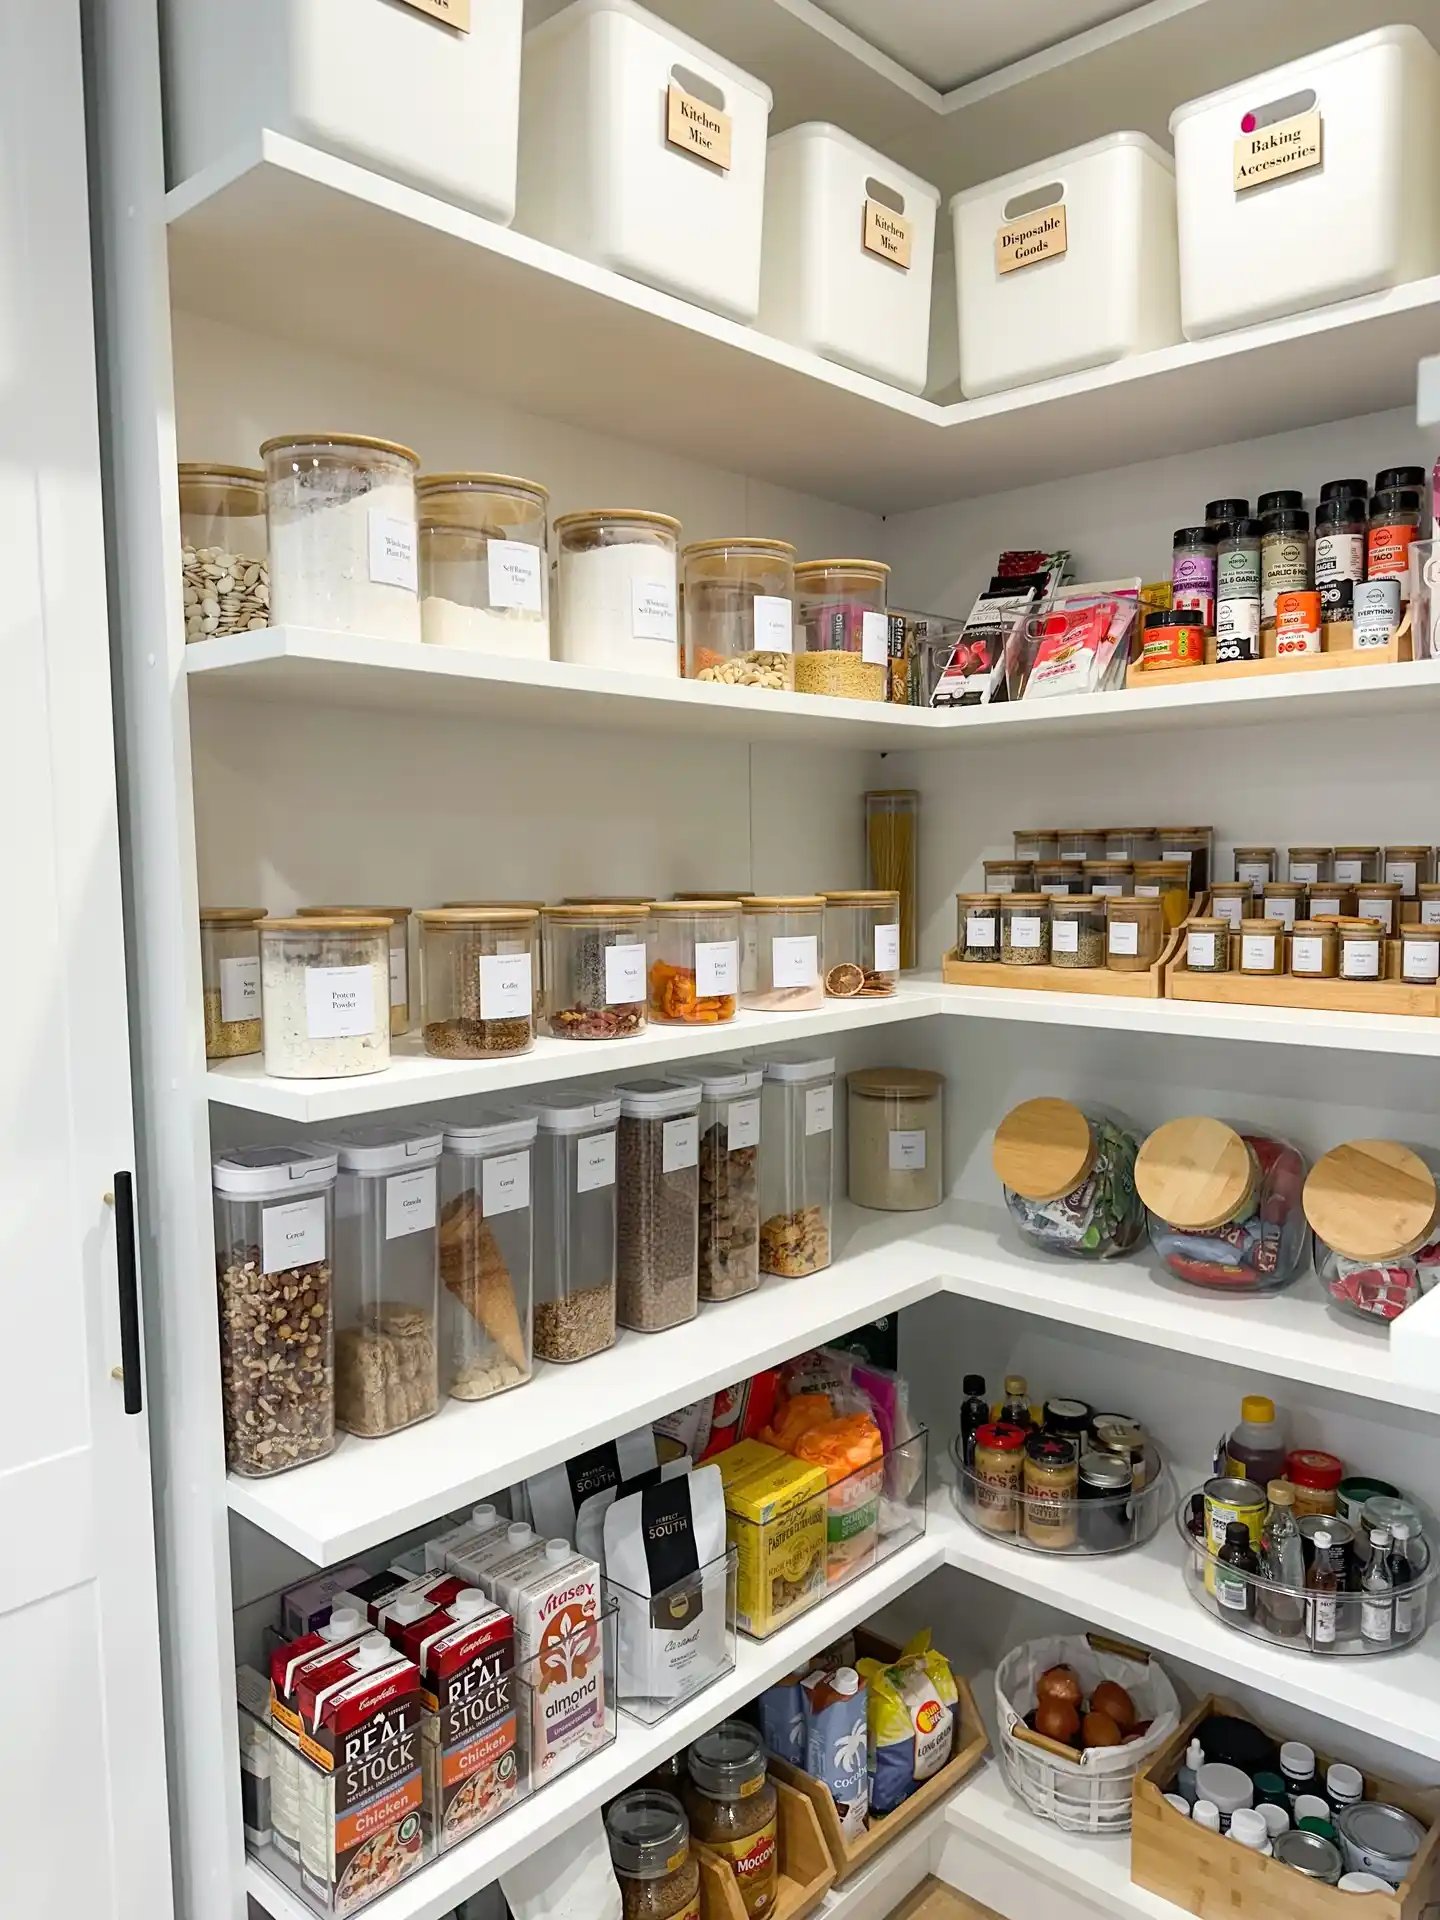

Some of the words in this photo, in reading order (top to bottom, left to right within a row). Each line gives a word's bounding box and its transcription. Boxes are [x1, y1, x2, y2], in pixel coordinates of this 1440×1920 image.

[680, 100, 721, 134] Kitchen
[688, 125, 713, 149] Misc
[1251, 129, 1301, 155] Baking
[1237, 145, 1316, 179] Accessories
[874, 213, 905, 240] Kitchen
[1002, 217, 1061, 248] Disposable
[880, 234, 899, 254] Misc
[1015, 240, 1049, 260] Goods
[1373, 553, 1393, 562] TACO
[1268, 569, 1292, 578] GARLIC
[1358, 608, 1394, 617] EVERYTHING
[332, 991, 356, 1000] Protein
[332, 1001, 356, 1010] Powder
[285, 1230, 305, 1241] Cereal
[576, 1471, 616, 1493] SOUTH
[648, 1519, 688, 1540] SOUTH
[655, 1512, 679, 1524] PERFECT
[459, 1631, 492, 1656] Campbell's
[359, 1684, 397, 1711] Campbell's
[448, 1658, 508, 1713] REAL
[545, 1675, 596, 1719] almond
[450, 1683, 511, 1735] STOCK
[450, 1725, 476, 1742] NATURAL
[475, 1703, 510, 1728] INGREDIENTS
[553, 1708, 593, 1736] Unsweetened
[564, 1703, 580, 1717] MILK
[345, 1713, 414, 1772] REAL
[458, 1734, 506, 1769] Chicken
[917, 1738, 937, 1758] LONG
[936, 1725, 952, 1745] GRAIN
[346, 1739, 414, 1796] STOCK
[347, 1784, 375, 1804] NATURAL
[375, 1762, 414, 1788] INGREDIENTS
[355, 1794, 409, 1832] Chicken
